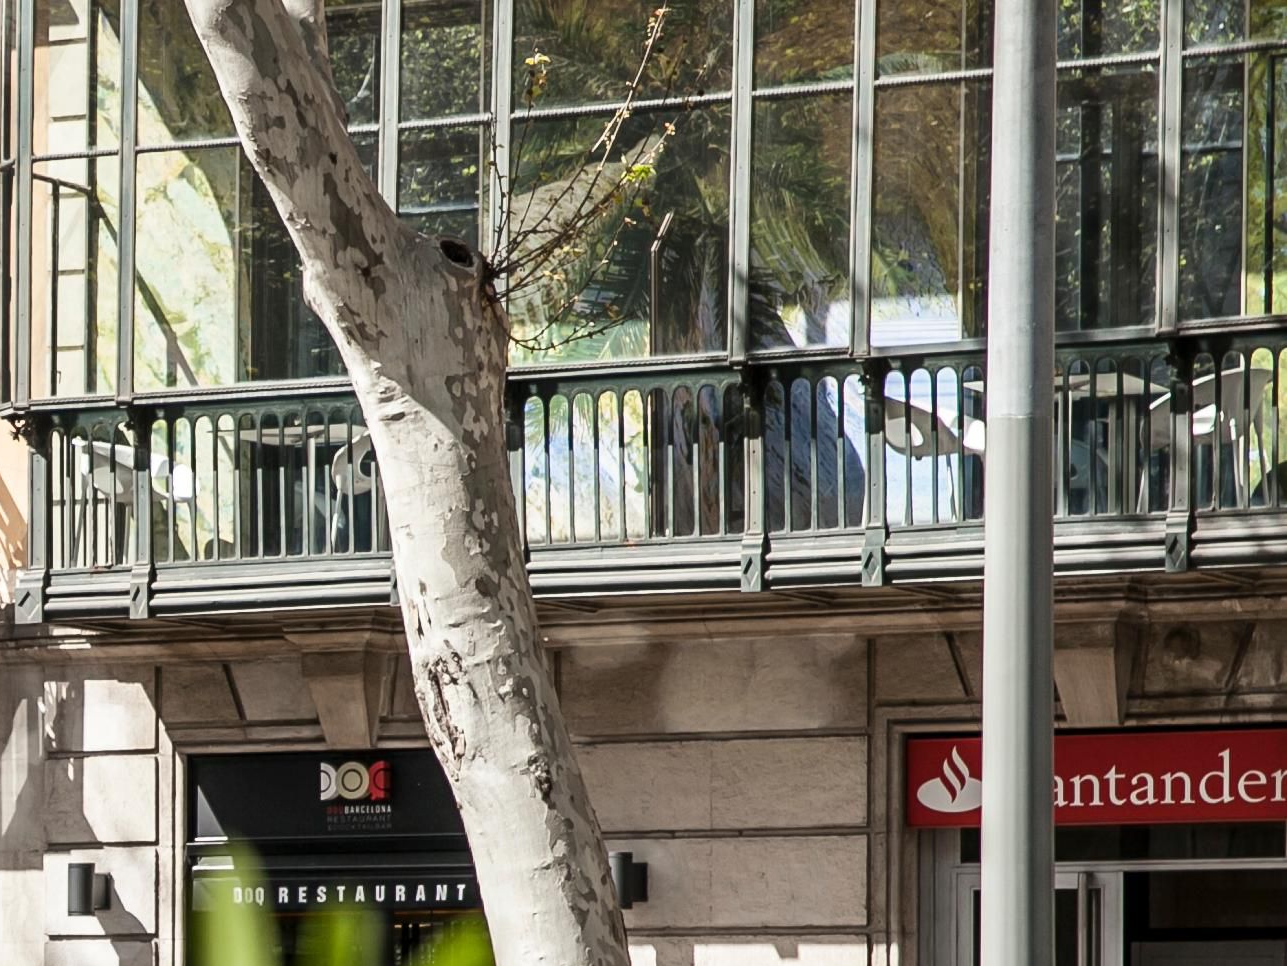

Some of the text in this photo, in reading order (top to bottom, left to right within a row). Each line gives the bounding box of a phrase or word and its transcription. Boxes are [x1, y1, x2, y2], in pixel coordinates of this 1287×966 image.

[1053, 747, 1287, 808] antander
[233, 884, 467, 906] DOQ RESTAURANT
